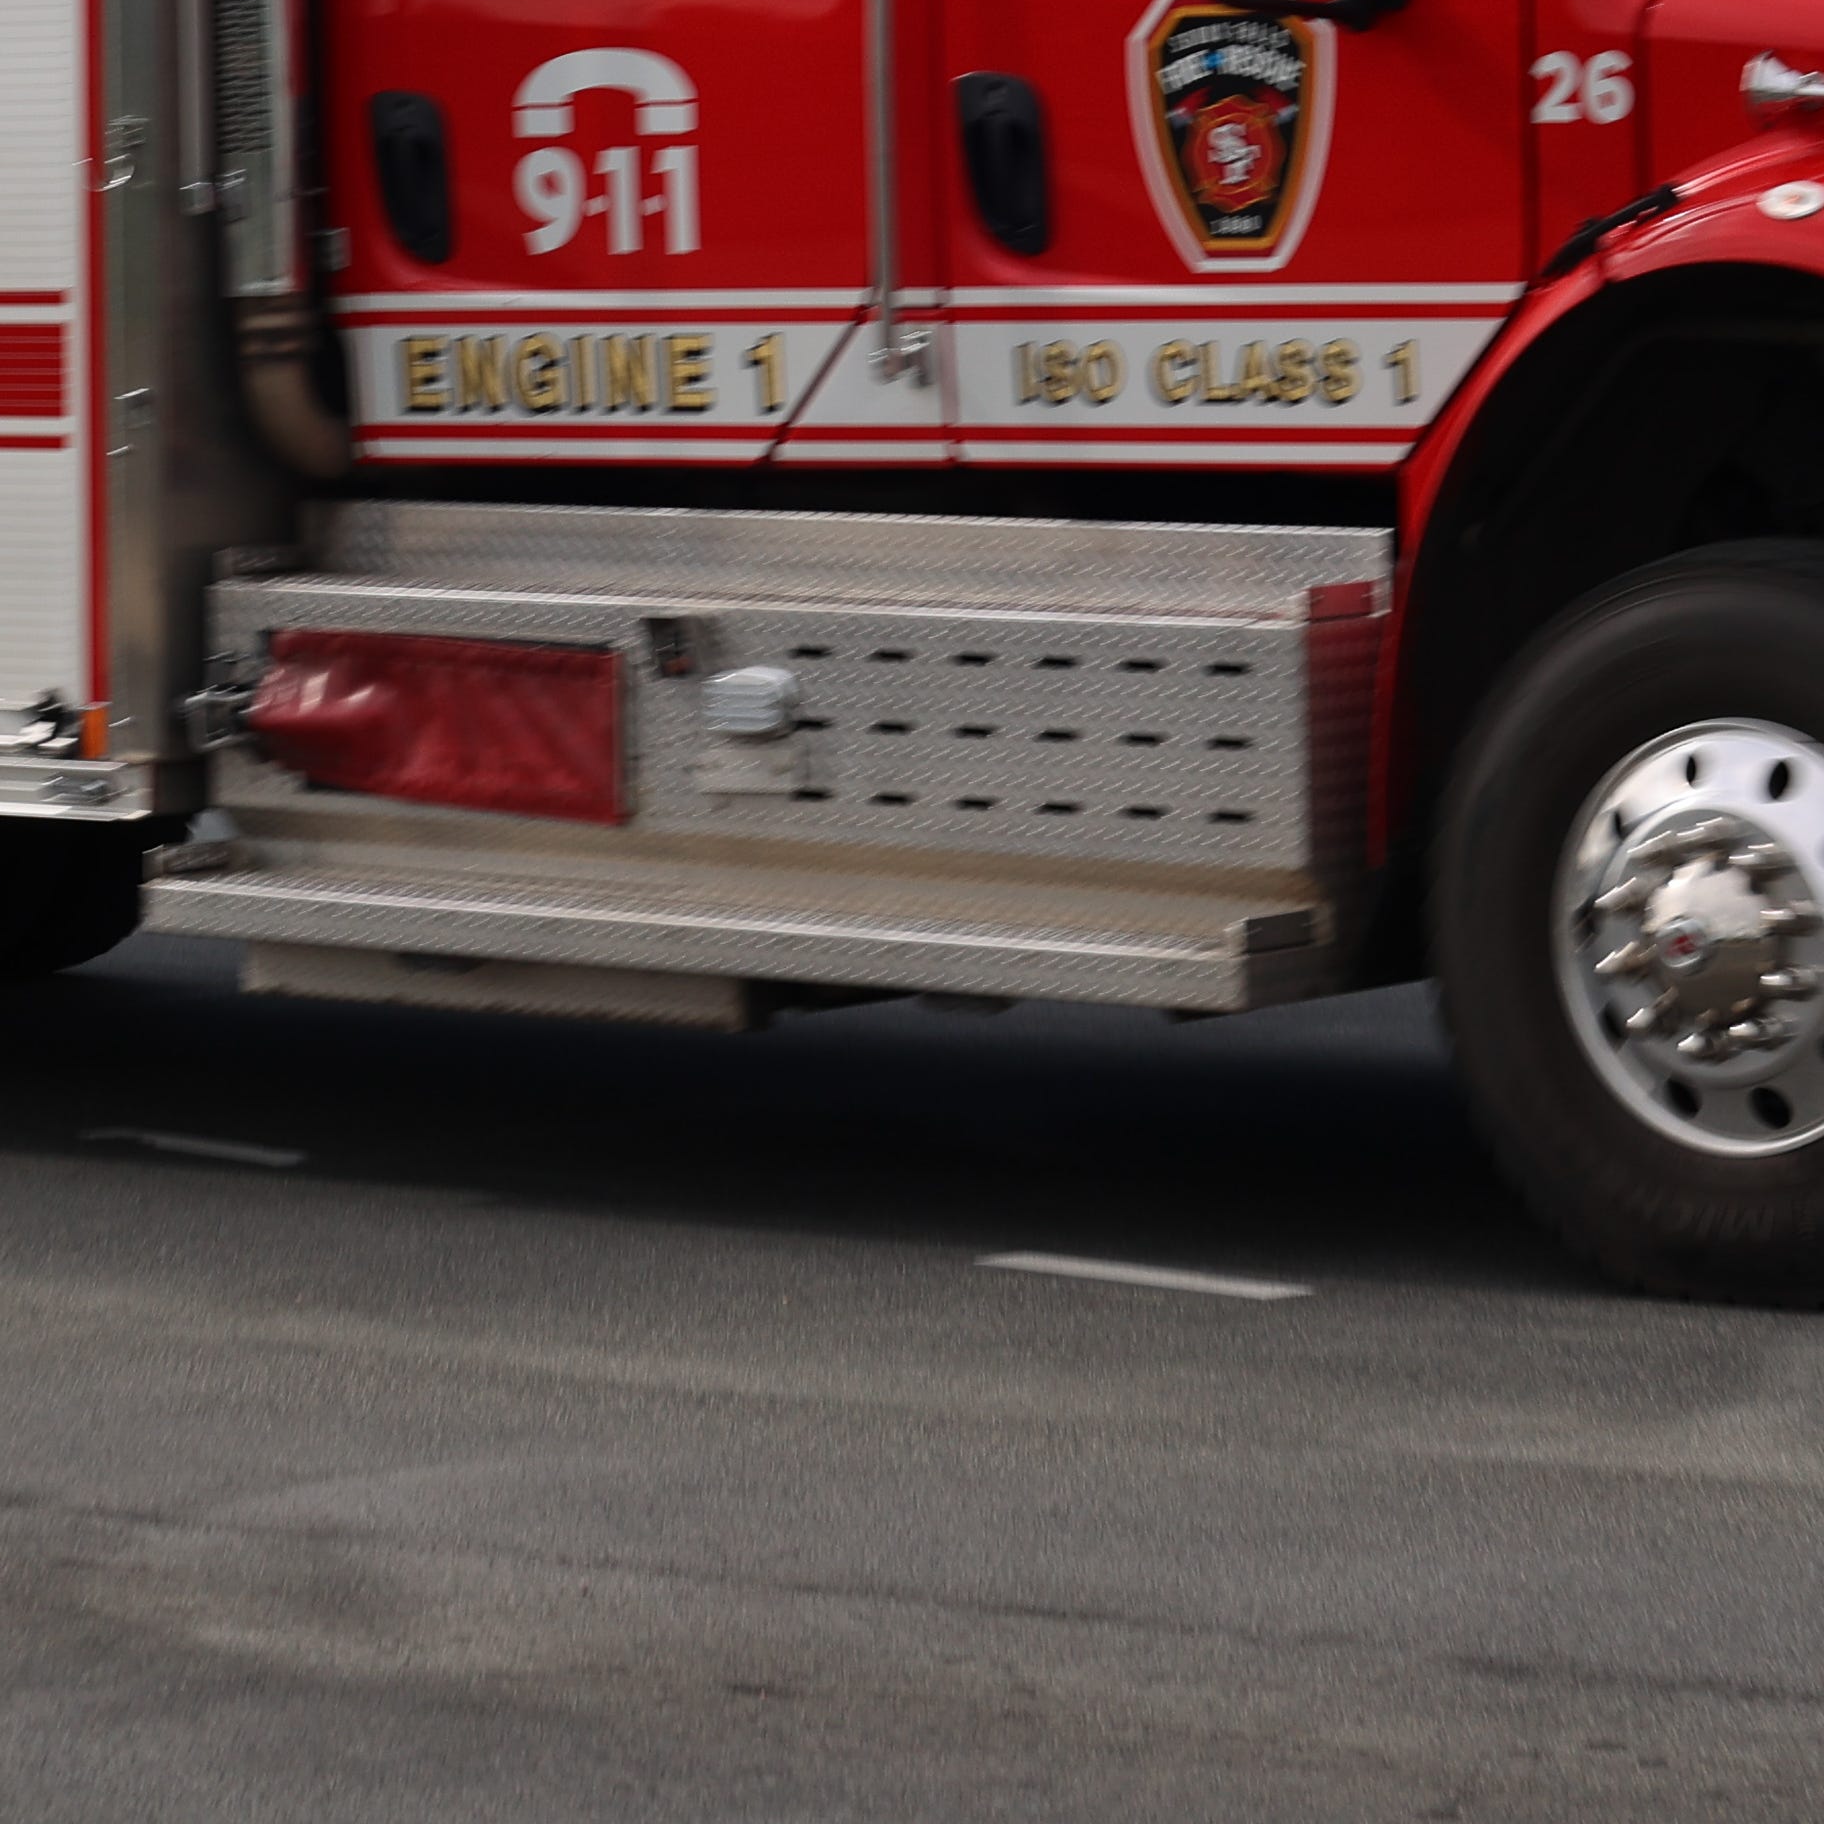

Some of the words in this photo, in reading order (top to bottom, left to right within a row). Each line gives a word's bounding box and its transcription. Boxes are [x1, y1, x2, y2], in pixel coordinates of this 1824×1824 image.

[1529, 49, 1635, 125] 26
[399, 332, 717, 414] ENGINE
[745, 330, 787, 414] 1
[1015, 338, 1121, 406] ISO
[1152, 337, 1360, 406] CLASS
[1386, 337, 1421, 406] 1
